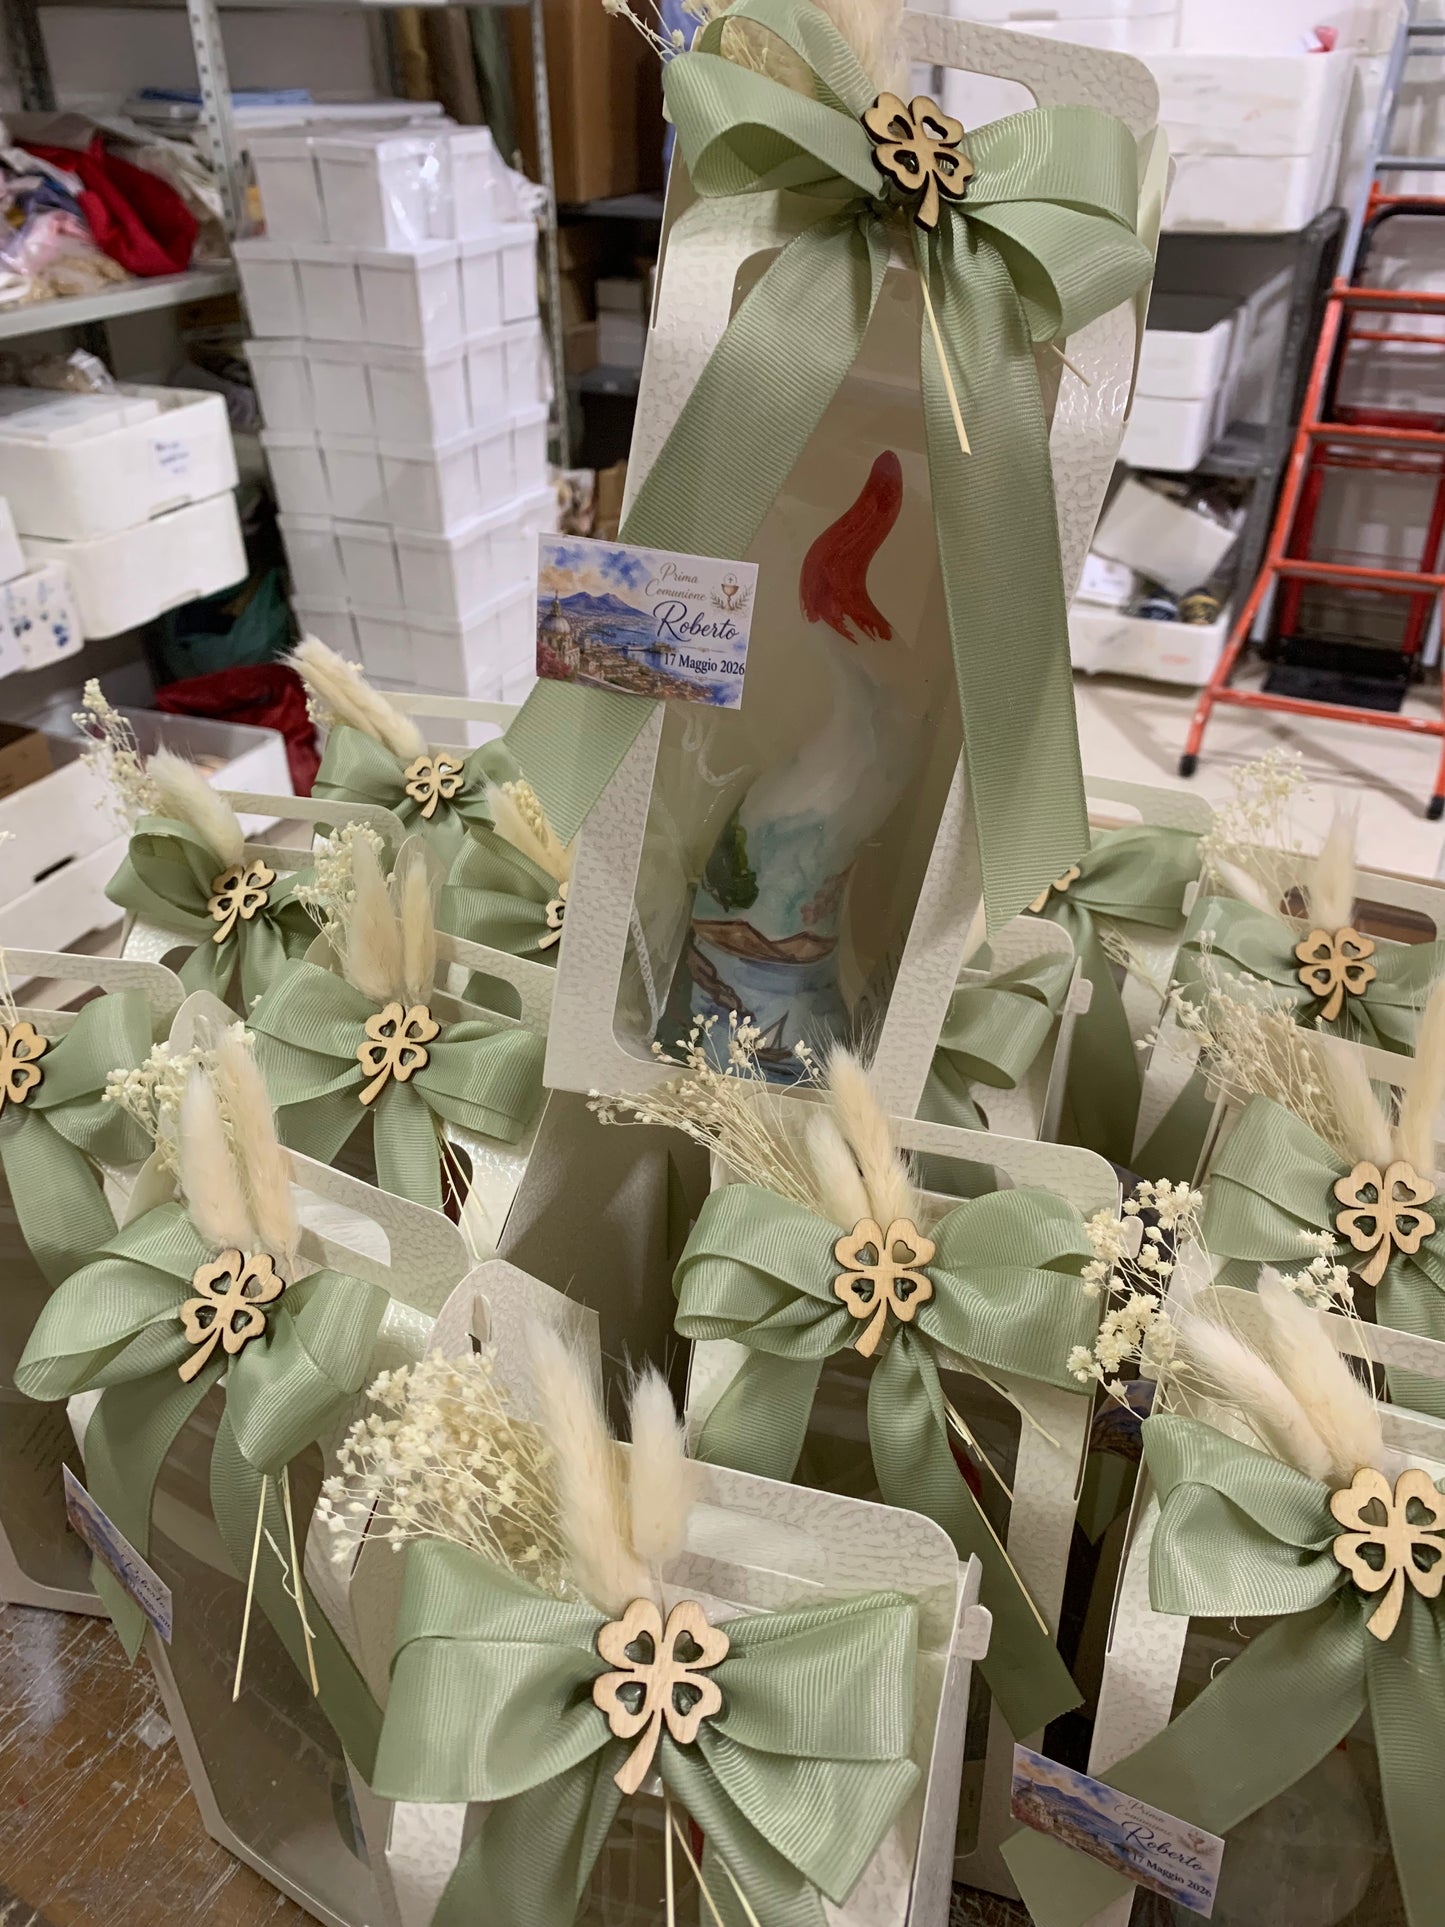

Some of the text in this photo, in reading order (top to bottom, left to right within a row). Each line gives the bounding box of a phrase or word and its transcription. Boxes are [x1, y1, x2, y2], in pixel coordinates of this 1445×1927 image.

[660, 561, 699, 583] Prima
[645, 578, 708, 601] Comunione
[653, 600, 740, 642] Roberto
[664, 653, 745, 675] 17 Maggio 2026
[1121, 1821, 1205, 1871] Roberto
[1147, 1859, 1185, 1884] Maggio
